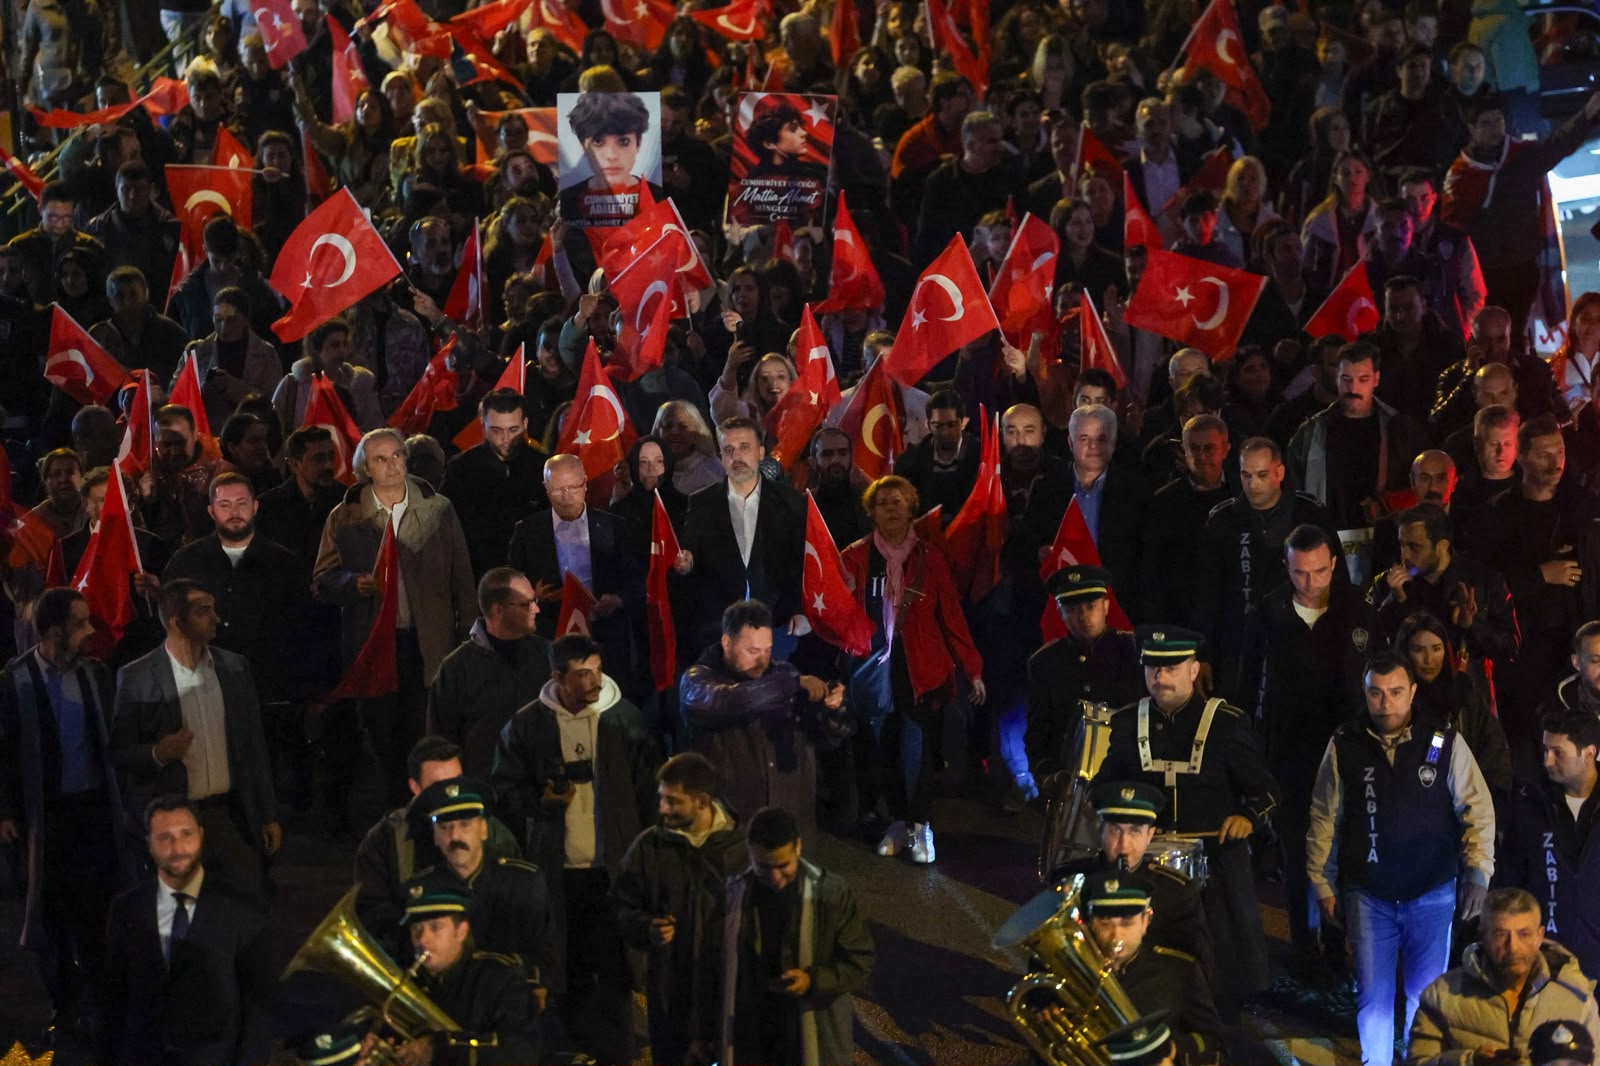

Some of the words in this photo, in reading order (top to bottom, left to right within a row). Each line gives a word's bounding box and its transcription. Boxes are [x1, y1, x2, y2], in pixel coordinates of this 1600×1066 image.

[741, 178, 787, 187] CUMHURİYET
[584, 192, 640, 205] CUMHURİYET
[733, 186, 778, 207] Mattia
[778, 187, 821, 206] Ahmet
[1363, 767, 1379, 864] ZABITA
[1542, 832, 1559, 934] ZABITA
